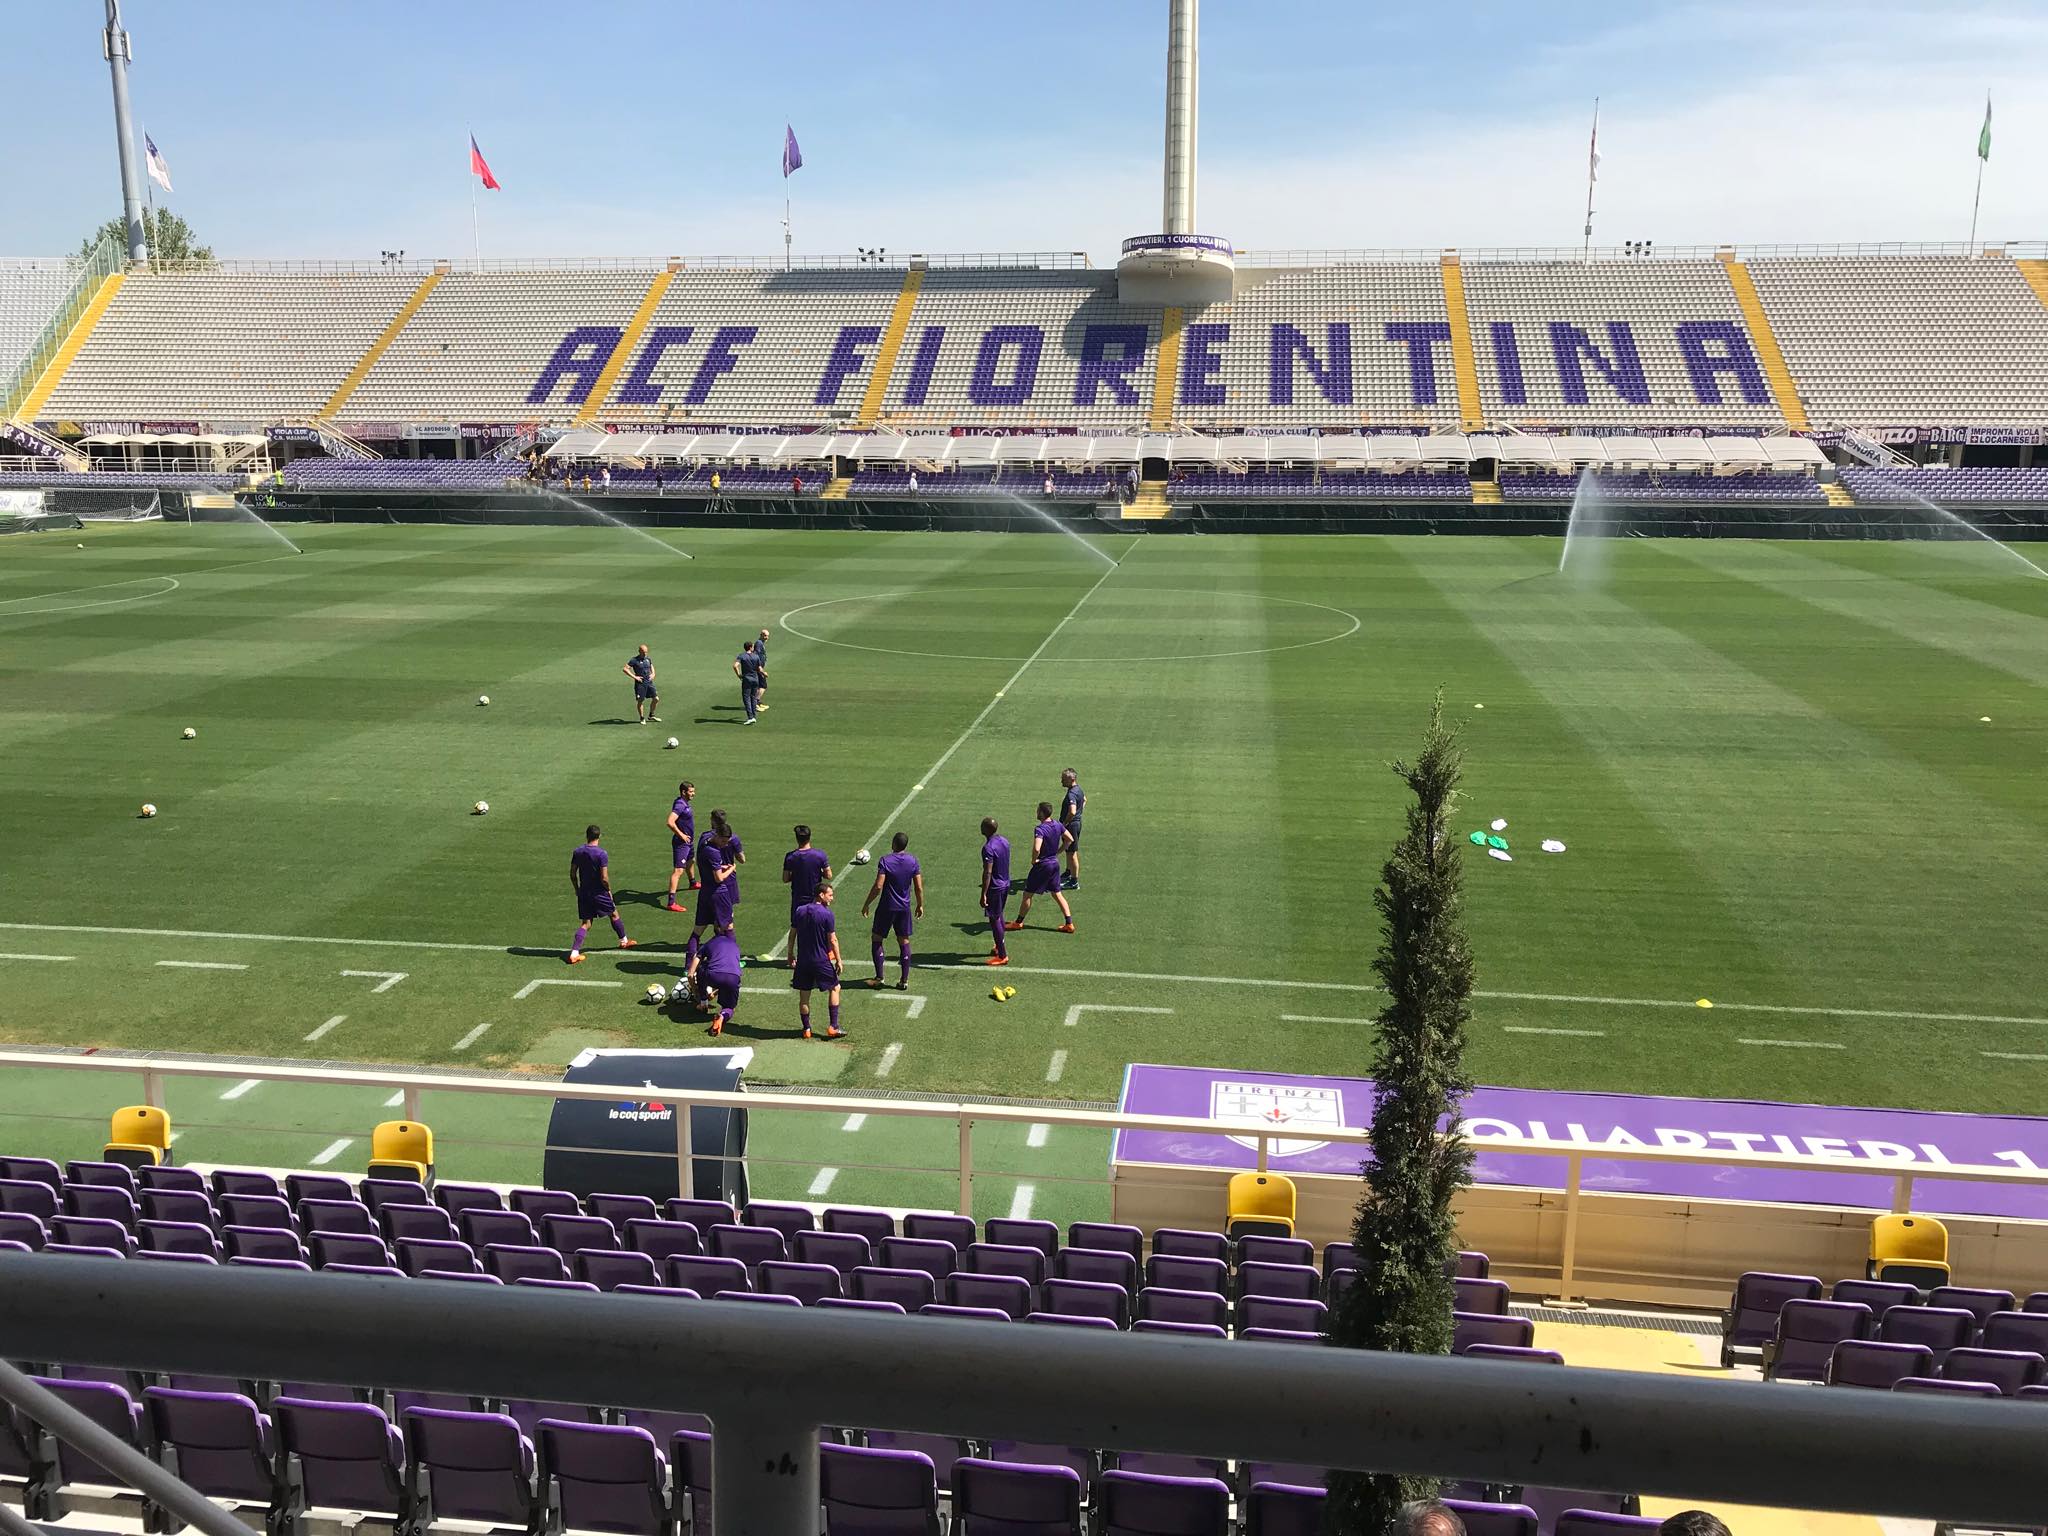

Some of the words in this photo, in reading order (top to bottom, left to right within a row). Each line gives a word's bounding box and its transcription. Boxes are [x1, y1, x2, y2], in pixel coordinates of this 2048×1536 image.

[527, 326, 760, 405] ACF
[815, 321, 1776, 406] FIORENTINA
[1260, 428, 1284, 436] VIOLA
[1286, 428, 1308, 436] CLUB
[1595, 427, 1611, 437] SAN
[2016, 428, 2039, 436] VIOLA
[1224, 1085, 1328, 1098] FIRENZE
[609, 1109, 619, 1119] le
[619, 1111, 638, 1121] coq
[639, 1110, 672, 1121] sportif
